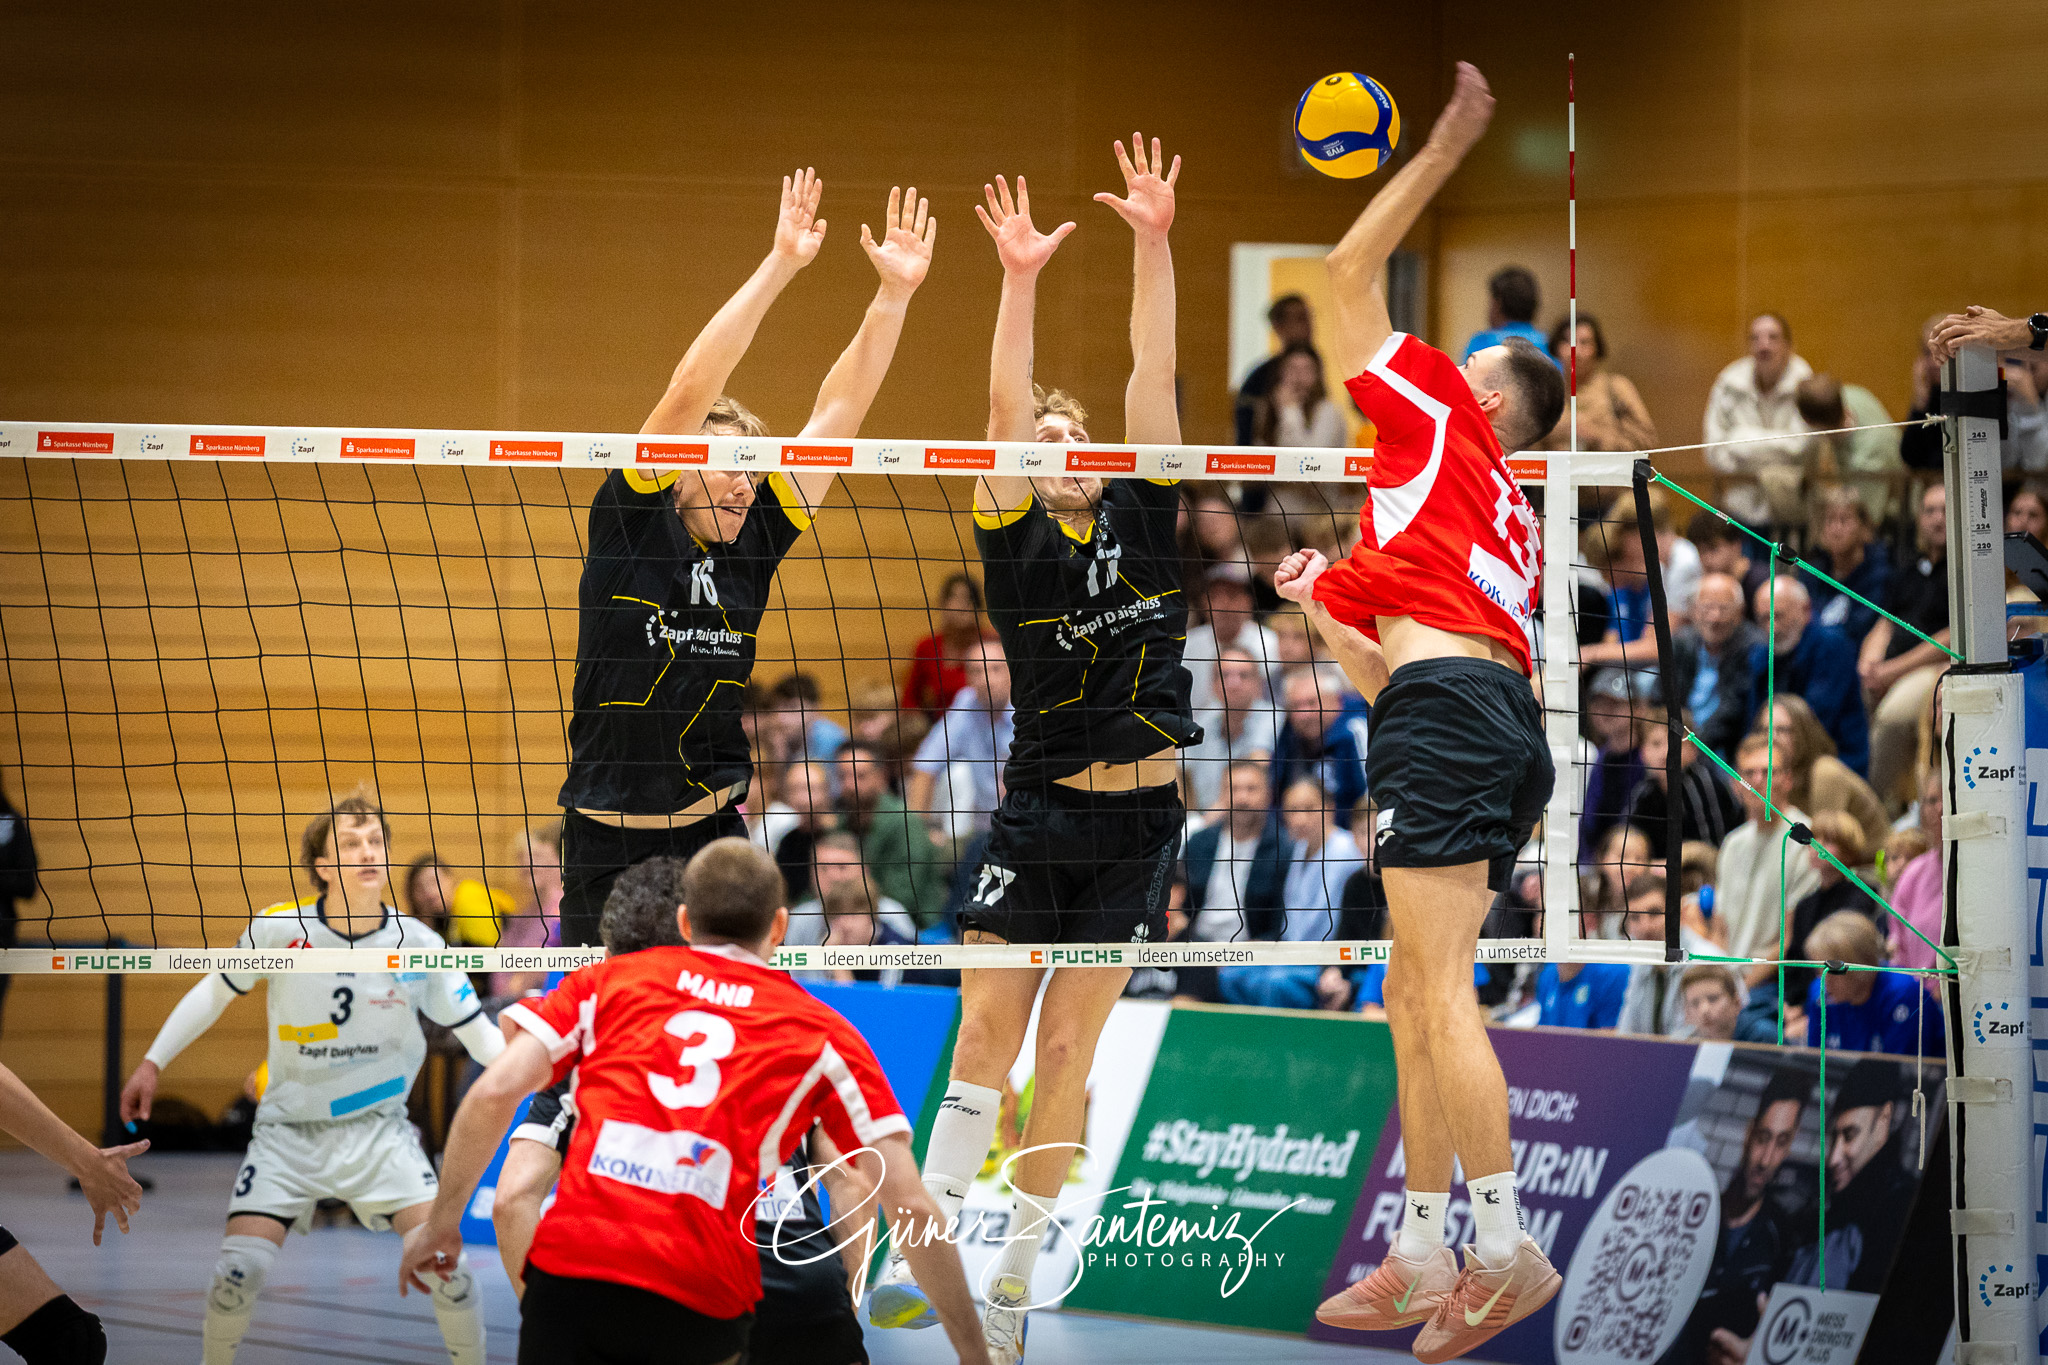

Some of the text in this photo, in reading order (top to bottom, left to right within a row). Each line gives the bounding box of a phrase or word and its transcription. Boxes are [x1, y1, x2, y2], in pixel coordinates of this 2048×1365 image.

[1325, 145, 1345, 157] FIVB
[0, 439, 11, 447] apf
[54, 441, 108, 449] Sparkasse Nürnberg
[206, 444, 260, 452] Sparkasse Nürnberg
[384, 447, 409, 455] Nürnberg
[504, 449, 558, 457] Sparkasse Nürnberg
[679, 452, 703, 460] Nürnberg
[796, 454, 847, 463] Sparkasse Nürnberg
[966, 457, 990, 465] Nürnberg
[1107, 460, 1131, 468] Nürnberg
[1220, 462, 1271, 471] Sparkasse Nürnberg
[690, 557, 718, 606] 16
[659, 625, 694, 644] Zapf
[1978, 765, 2015, 781] Zapf
[768, 951, 942, 967] CHS Ideen umsetzen
[1052, 949, 1254, 964] FUCHS Ideen umsetzen
[1488, 945, 1547, 959] umsetze
[75, 955, 294, 969] FUCHS Ideen umsetzen
[409, 953, 604, 969] FUCHS Ideen umsetz
[330, 986, 354, 1026] 3
[1989, 1021, 2024, 1037] Zapf
[647, 1009, 736, 1110] 3
[953, 1103, 981, 1117] cep
[1141, 1118, 1361, 1183] #StayHydrated
[235, 1164, 256, 1197] 3
[1994, 1283, 2030, 1299] Zapf
